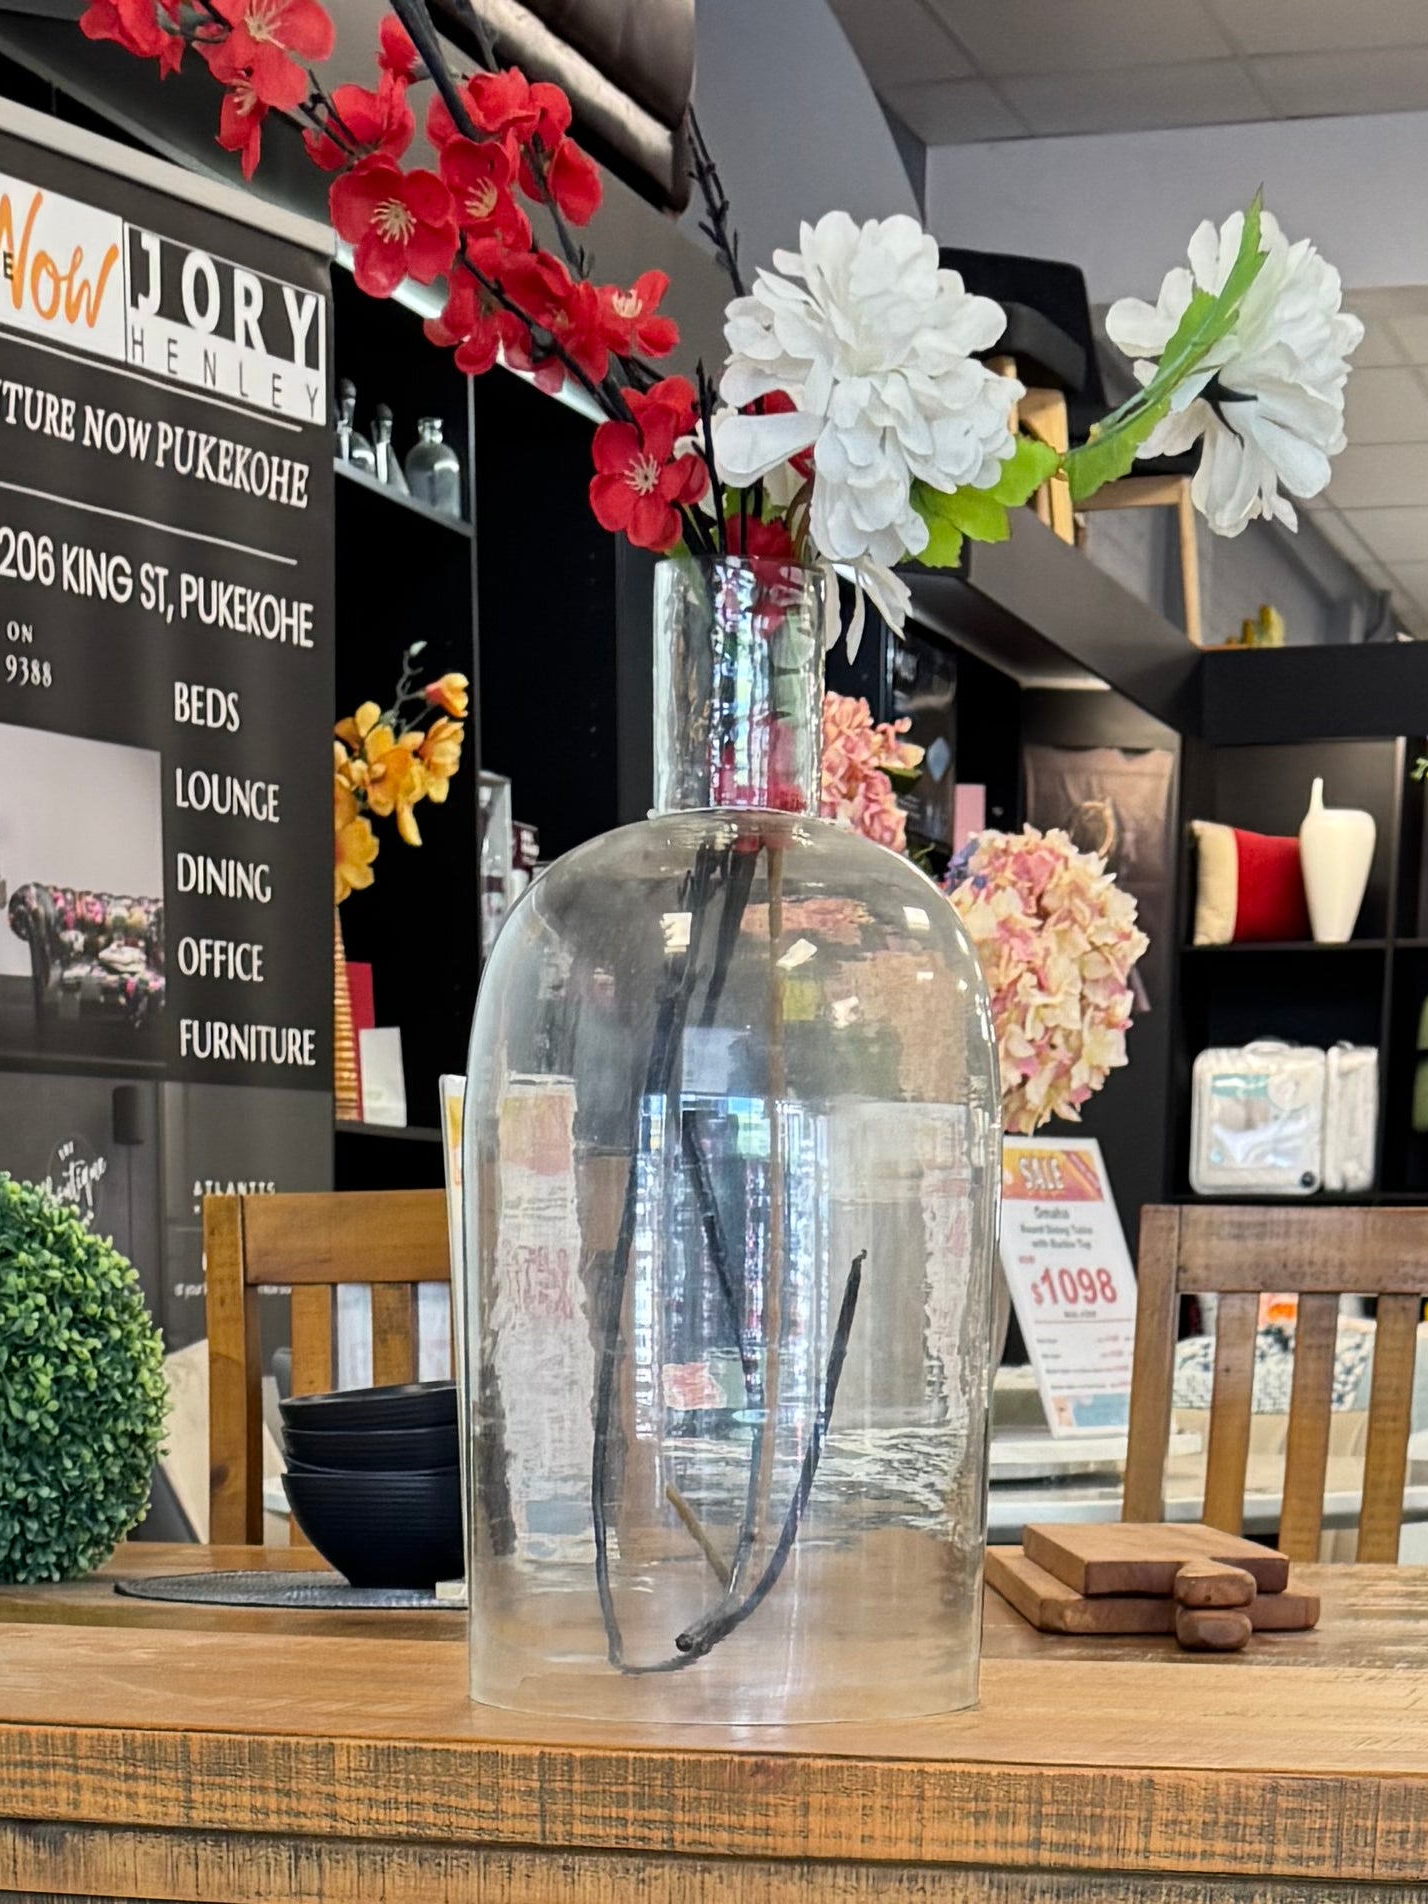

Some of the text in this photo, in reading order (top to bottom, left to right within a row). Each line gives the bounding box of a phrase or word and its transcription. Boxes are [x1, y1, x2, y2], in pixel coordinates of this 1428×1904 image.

[137, 232, 317, 370] JORY
[131, 324, 318, 419] HENLEY
[82, 405, 151, 462] NOW
[155, 421, 310, 509] PUKEKOHE
[62, 543, 133, 603] KING
[139, 562, 174, 625] ST,
[180, 573, 314, 648] PUKEKOHE
[5, 654, 53, 688] 9388
[174, 680, 241, 733] BEDS
[175, 767, 280, 823] LOUNGE
[176, 852, 273, 904] DINING
[177, 936, 265, 983] OFFICE
[179, 1018, 317, 1066] FURNITURE
[1019, 1156, 1065, 1191] SALE
[1030, 1266, 1117, 1306] $1098
